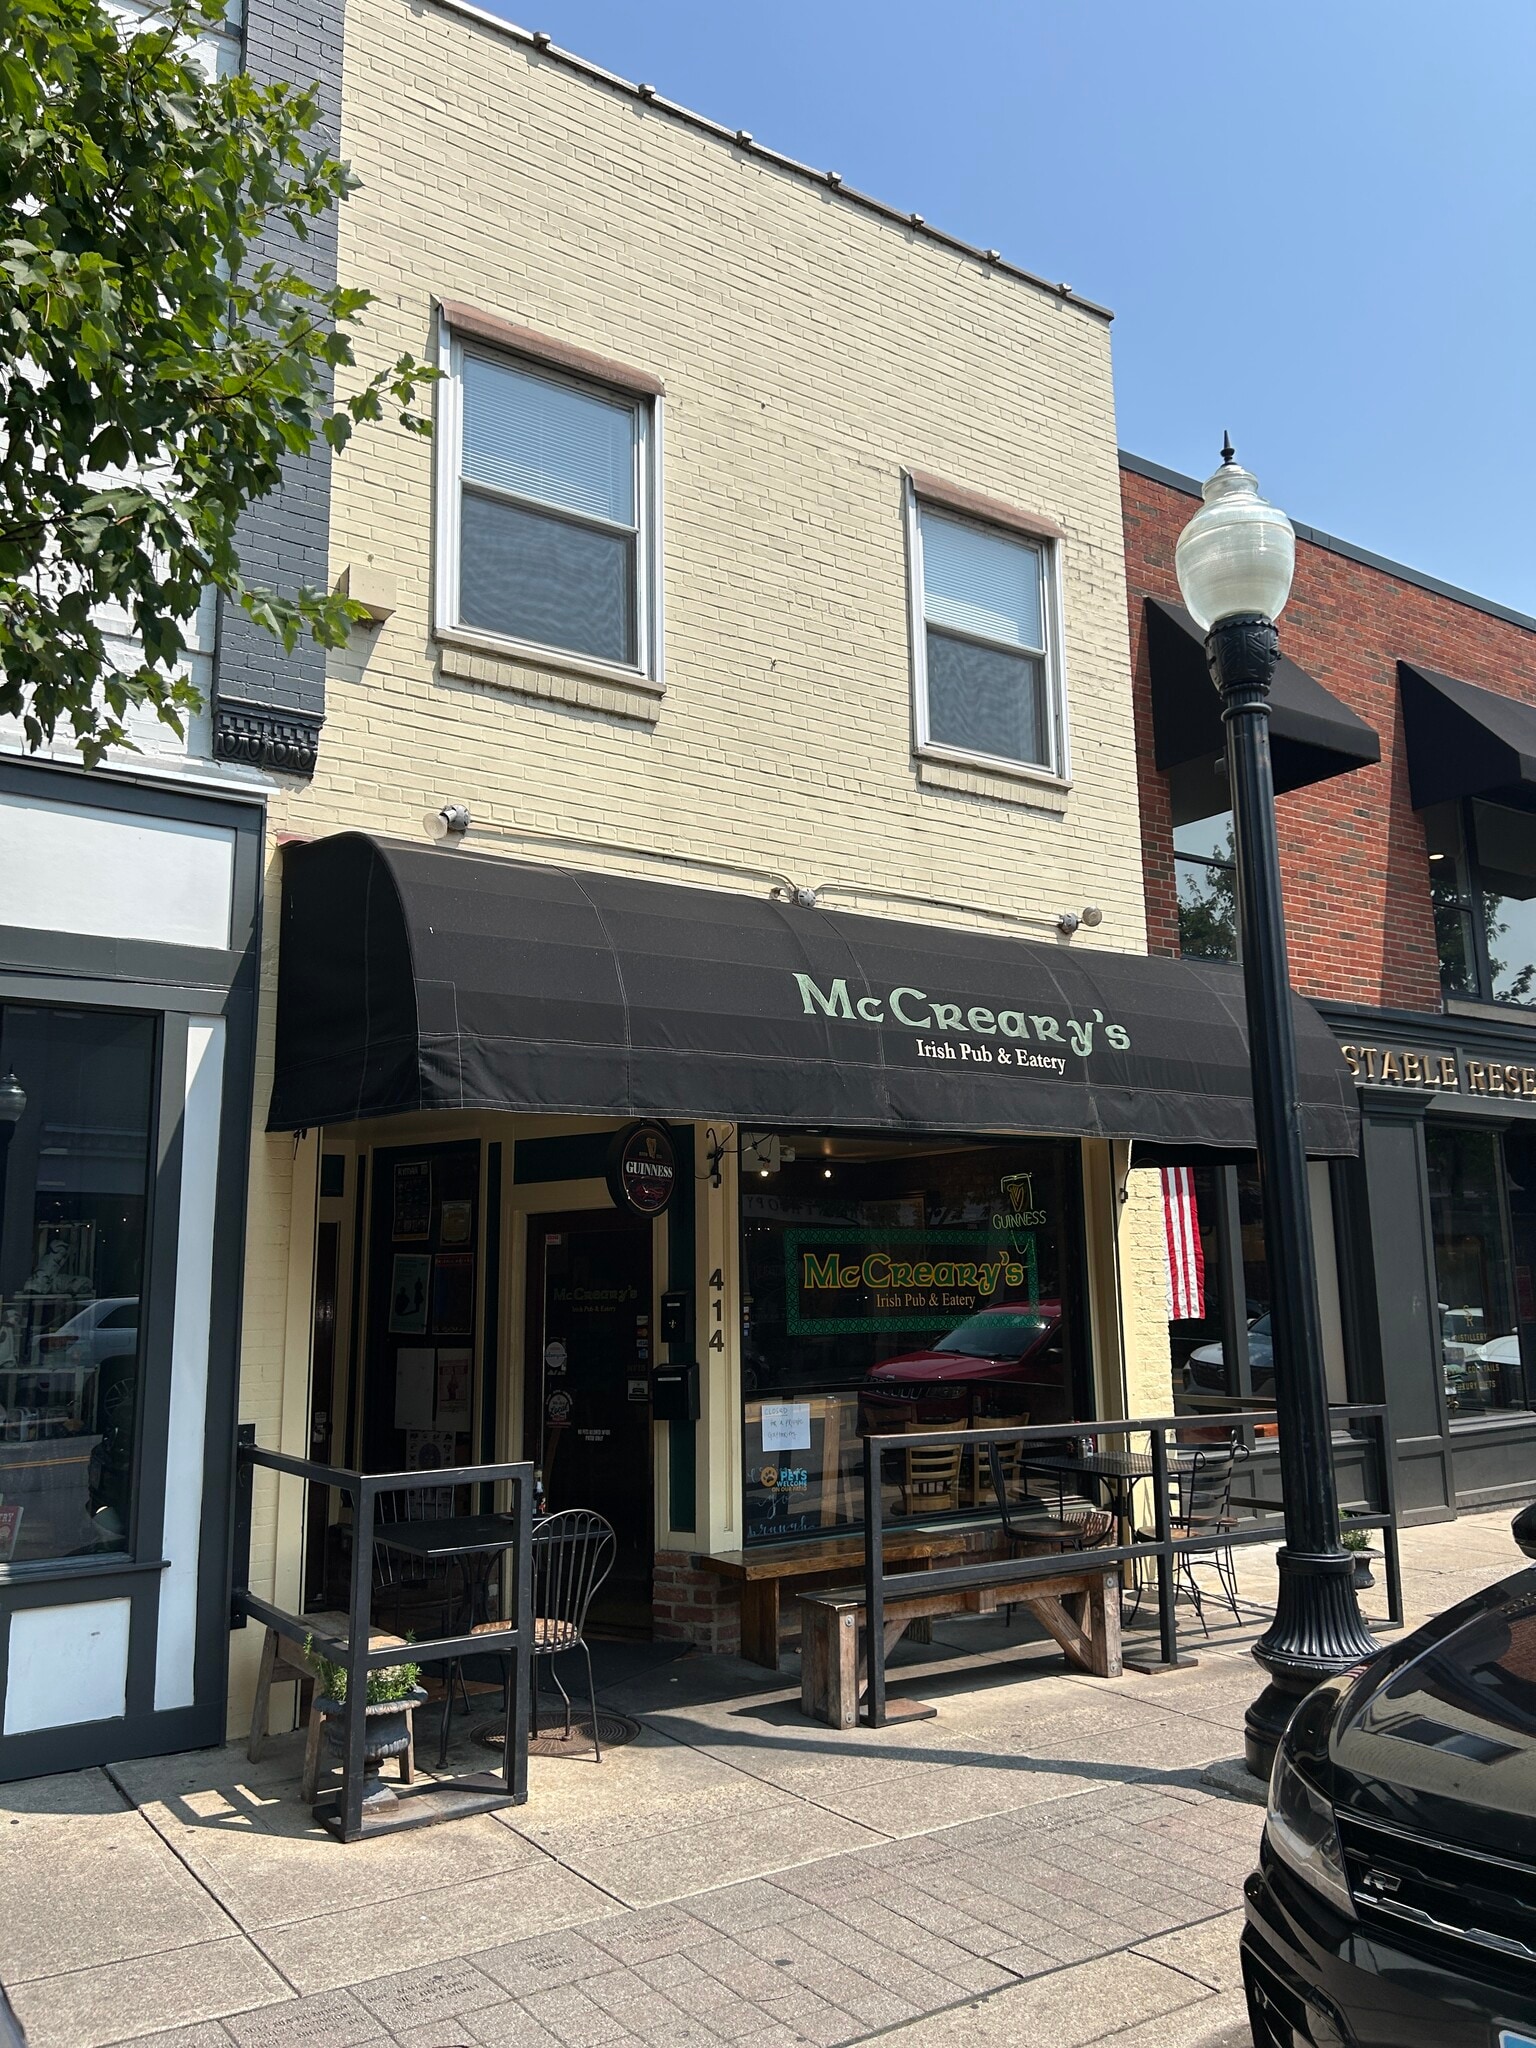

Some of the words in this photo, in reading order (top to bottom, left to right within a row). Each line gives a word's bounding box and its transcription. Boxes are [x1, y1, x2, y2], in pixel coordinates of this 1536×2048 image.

[792, 972, 1132, 1057] McCreary's
[916, 1039, 957, 1060] Irish
[960, 1042, 994, 1064] Pub
[997, 1050, 1012, 1066] &
[1016, 1049, 1067, 1075] Eatery
[1341, 1045, 1459, 1087] STABLE
[625, 1161, 673, 1178] GUINNESS
[992, 1210, 1048, 1230] GUINNESS
[803, 1251, 1025, 1296] McCreary's
[876, 1293, 902, 1308] Irish
[905, 1293, 926, 1308] Pub
[928, 1294, 939, 1307] &
[942, 1293, 976, 1309] Eatery
[1468, 1364, 1500, 1374] COTAILS
[776, 1480, 808, 1488] WELCOME
[780, 1469, 808, 1482] PETS
